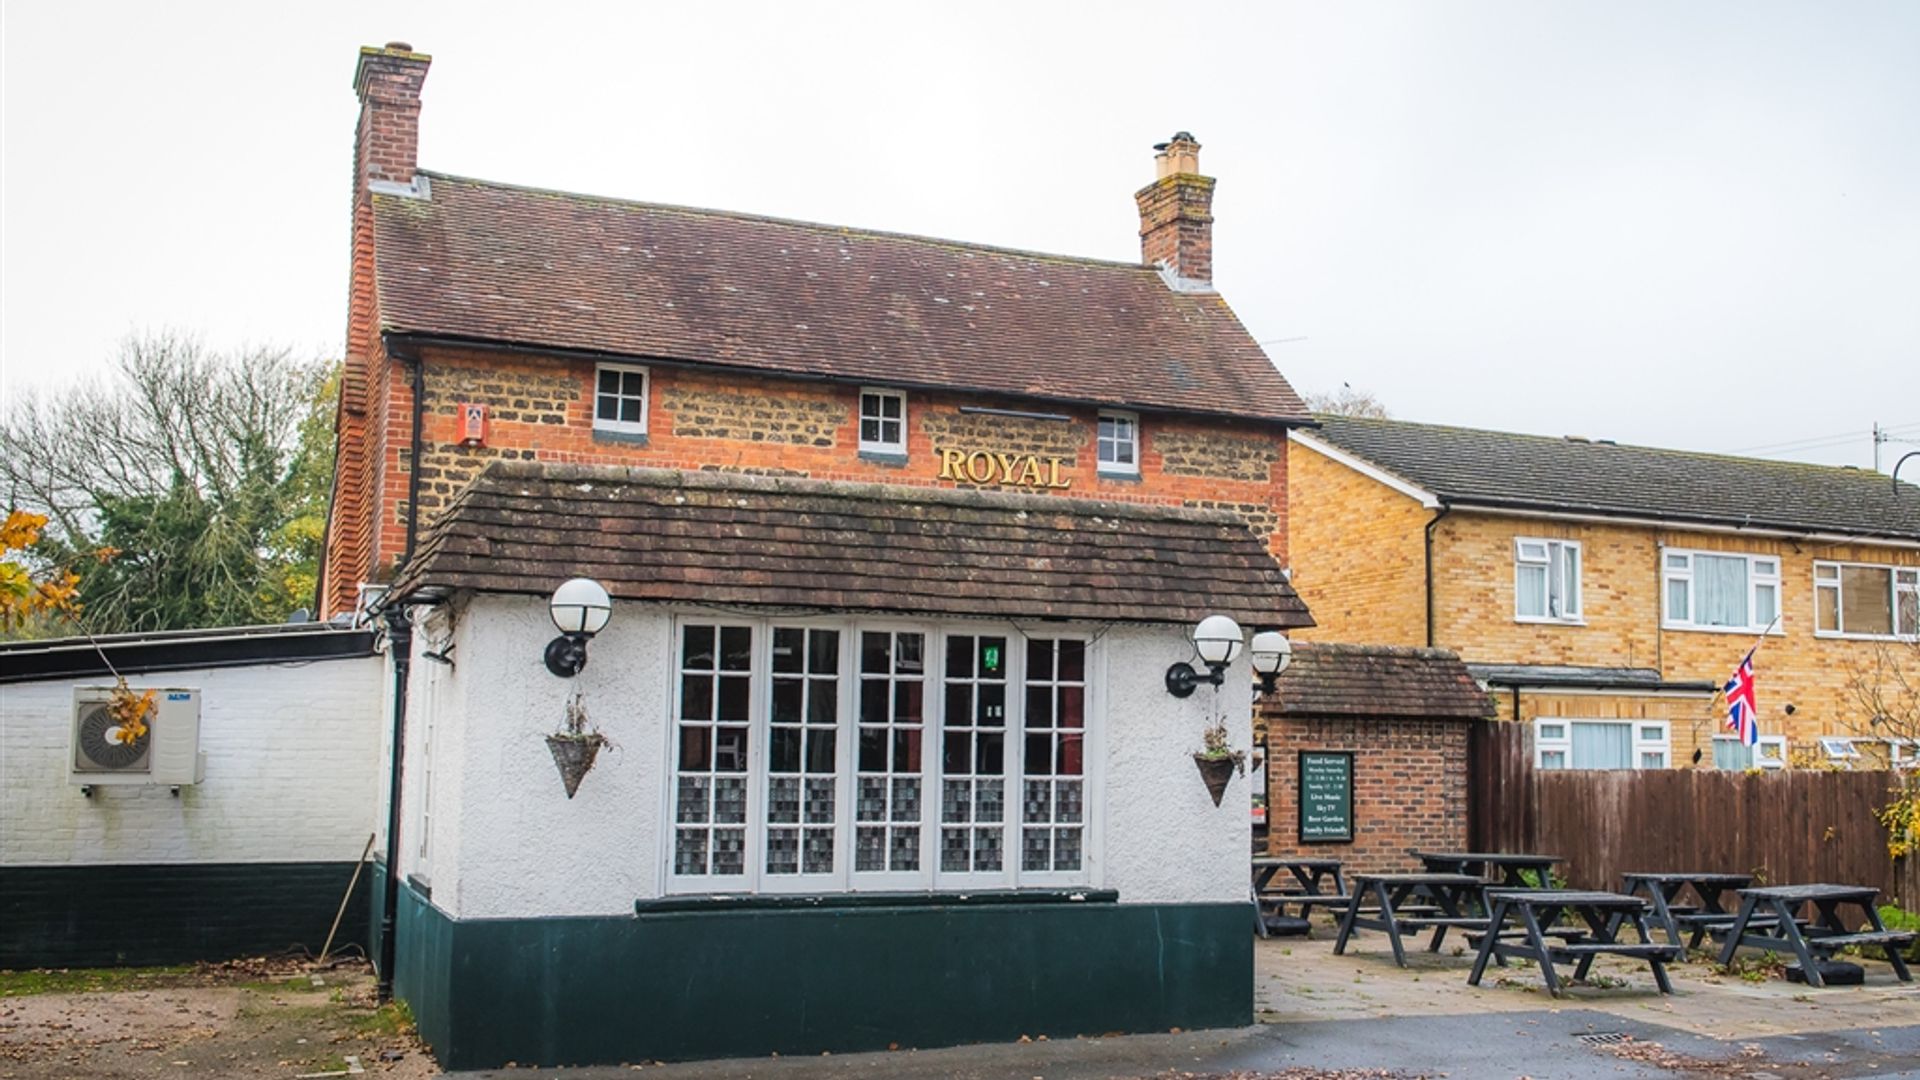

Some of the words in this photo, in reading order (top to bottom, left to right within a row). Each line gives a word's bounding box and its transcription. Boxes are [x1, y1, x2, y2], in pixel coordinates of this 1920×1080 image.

[938, 447, 1072, 488] ROYAL
[1306, 757, 1323, 765] Food
[1324, 757, 1346, 765] Served
[1310, 793, 1323, 801] Live
[1324, 793, 1341, 801] Music
[1316, 804, 1327, 813] Sky
[1303, 826, 1323, 835] Family
[1323, 826, 1348, 835] Friendly
